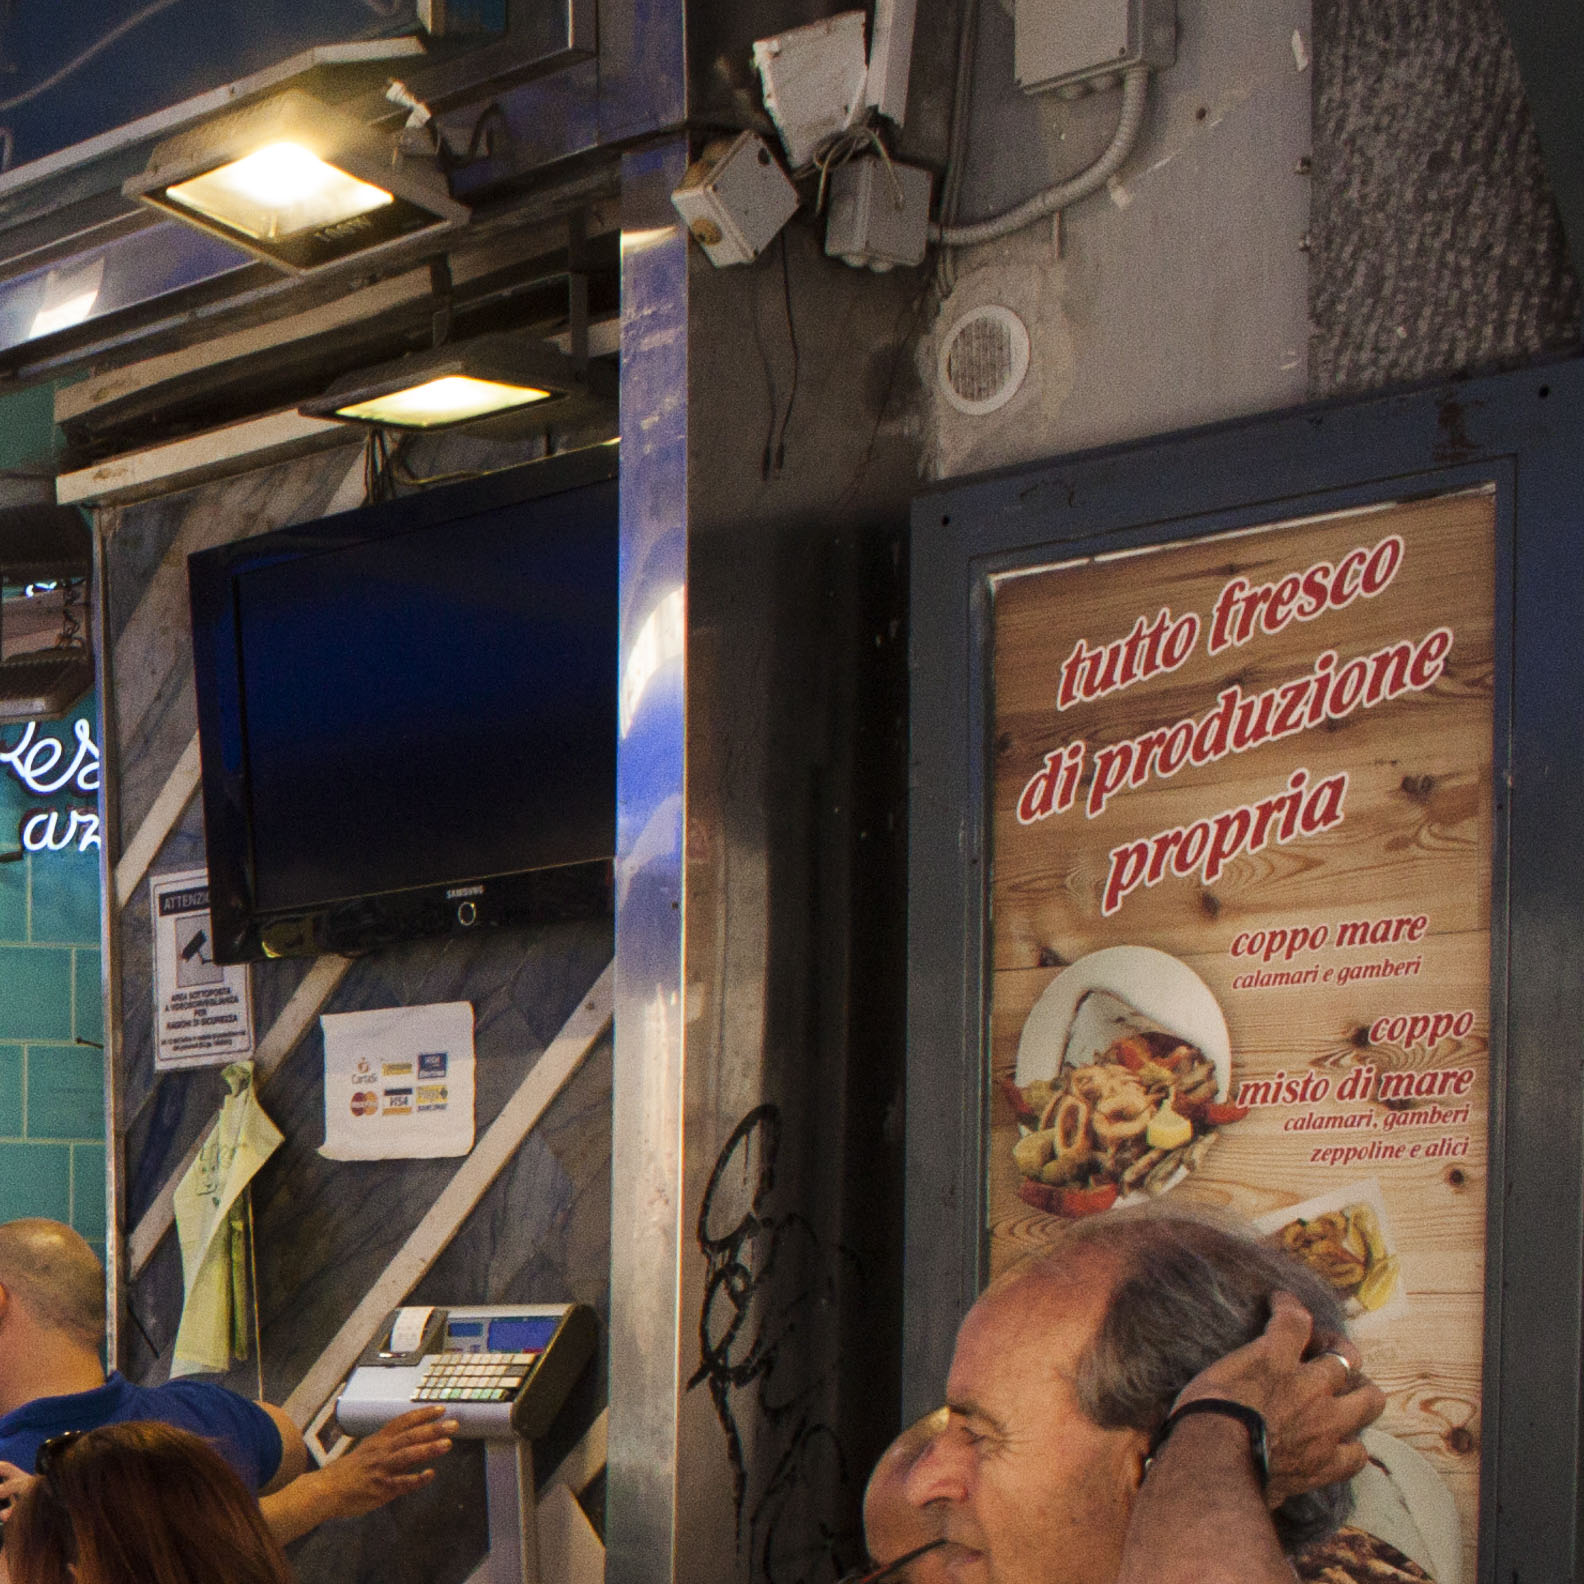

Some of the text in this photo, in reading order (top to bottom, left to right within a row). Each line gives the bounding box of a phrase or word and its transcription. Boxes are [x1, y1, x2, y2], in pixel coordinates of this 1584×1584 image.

[1057, 534, 1405, 711] tutto fresco
[1017, 627, 1454, 825] di produzione
[23, 809, 102, 851] az
[1101, 769, 1348, 917] propria
[1231, 914, 1429, 962] coppo mare
[1232, 956, 1422, 989] calamari e gamberi
[1369, 1011, 1474, 1049] coppo
[1236, 1065, 1475, 1109] misto di mare
[1284, 1104, 1471, 1131] calamari, gamberi
[1310, 1136, 1470, 1166] zeppoline e alici
